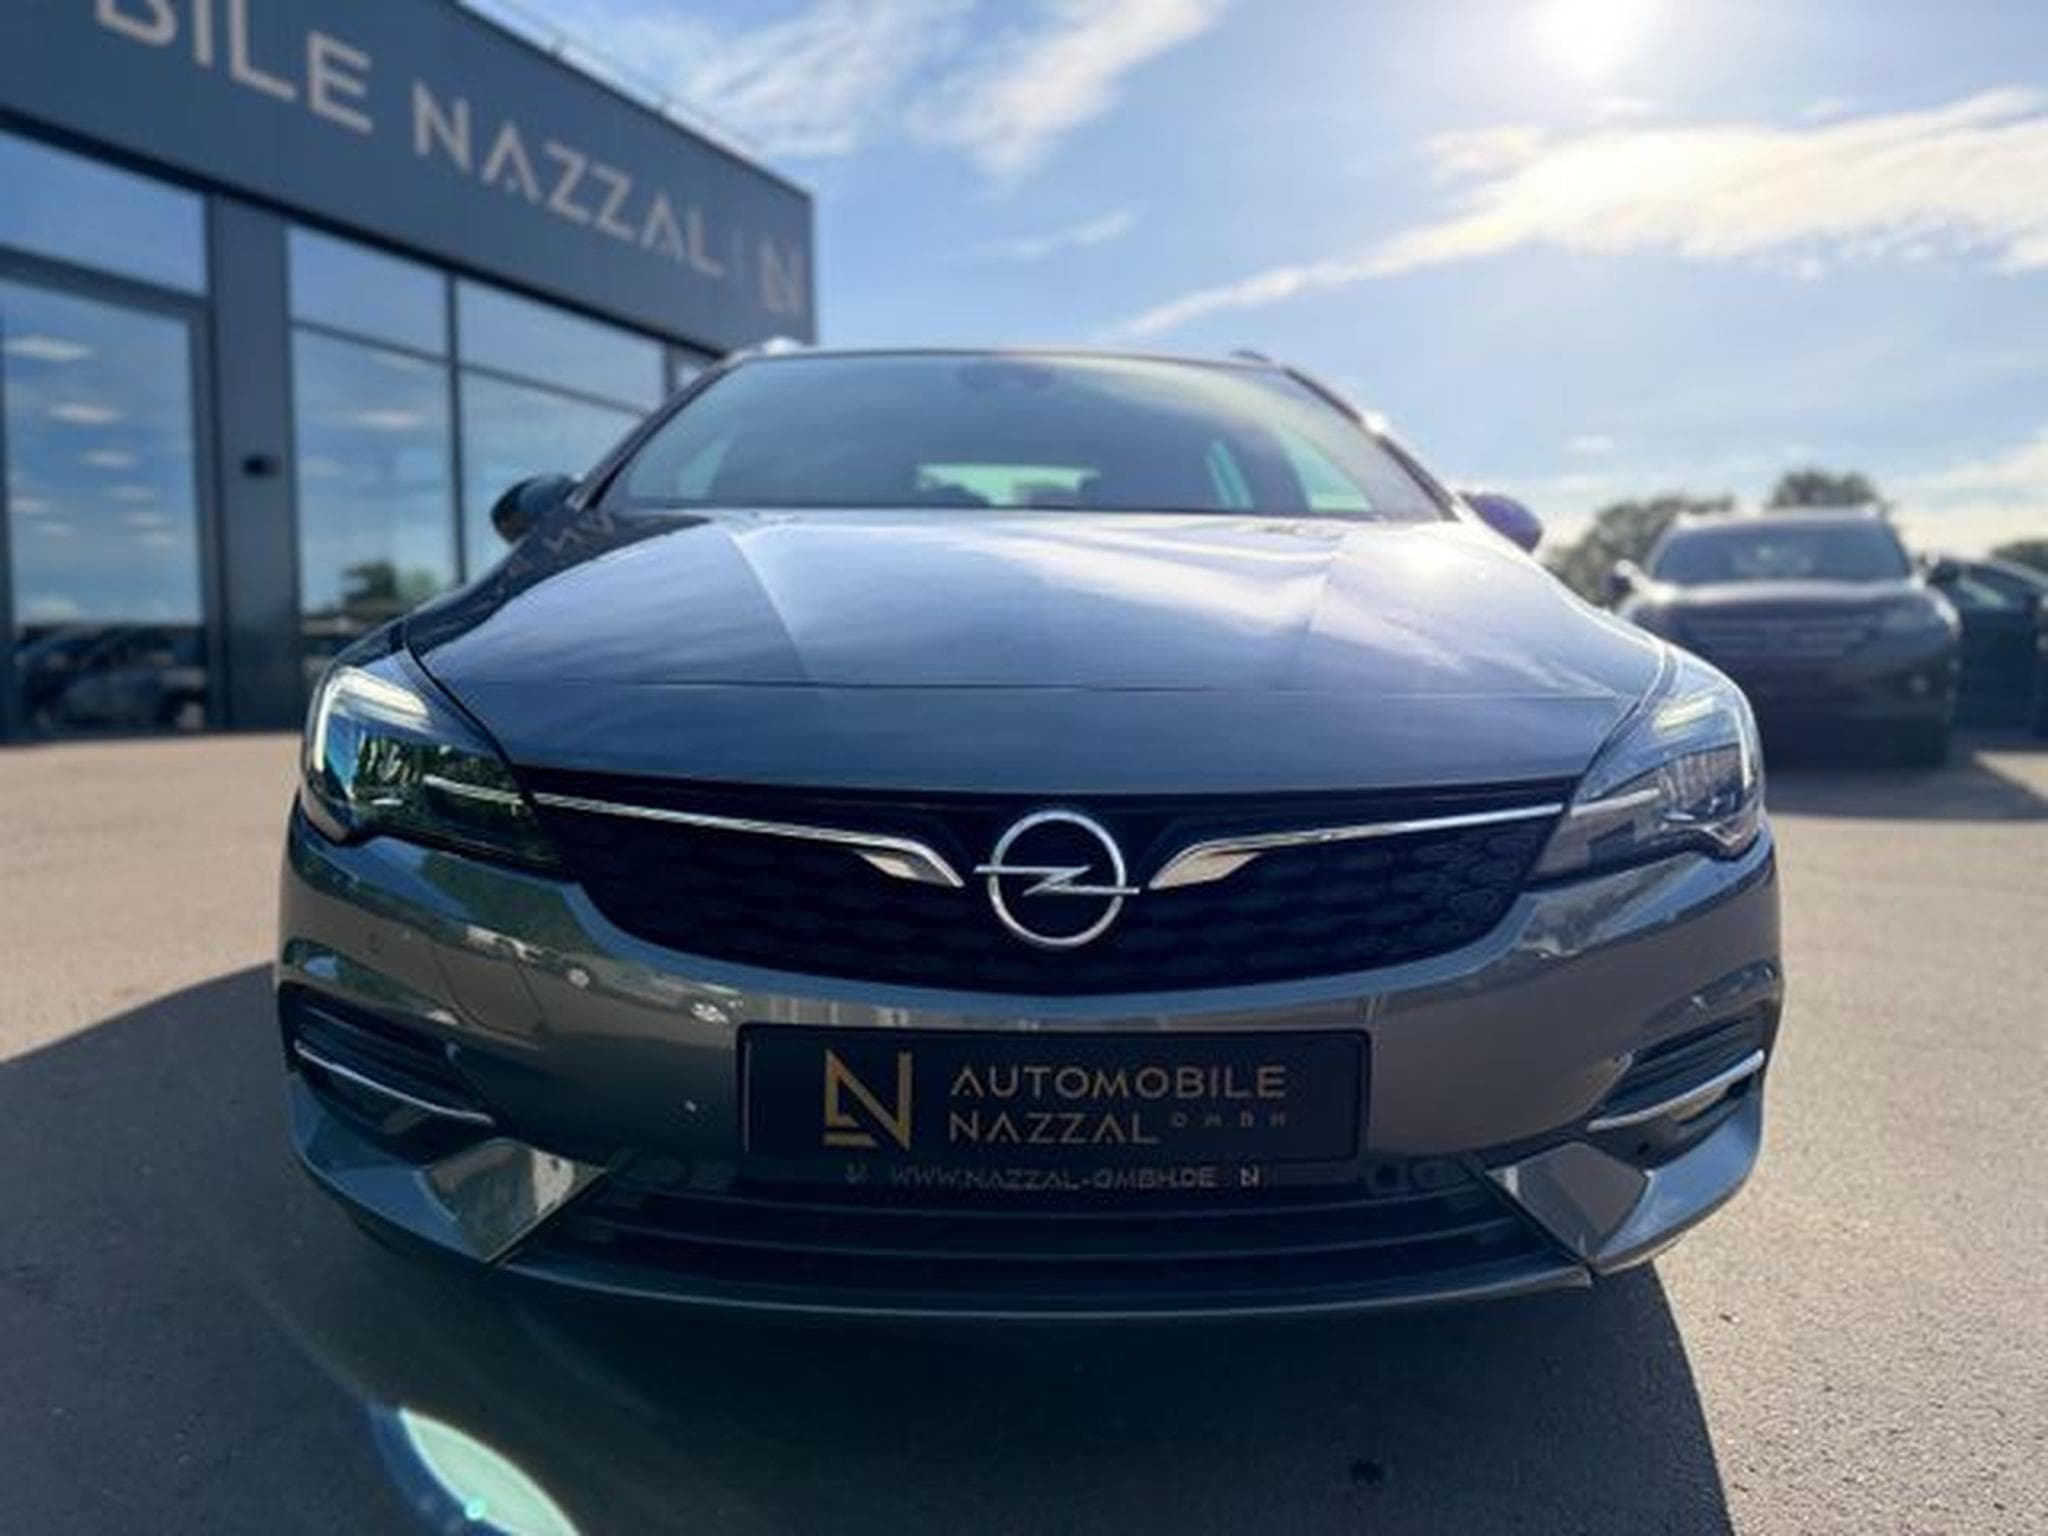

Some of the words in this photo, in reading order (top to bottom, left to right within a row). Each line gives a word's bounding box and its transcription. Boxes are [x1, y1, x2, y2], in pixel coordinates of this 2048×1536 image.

[411, 78, 725, 277] NAZZAL
[950, 1063, 1286, 1100] AUTOMOBILE
[949, 1109, 1160, 1145] NAZZAL
